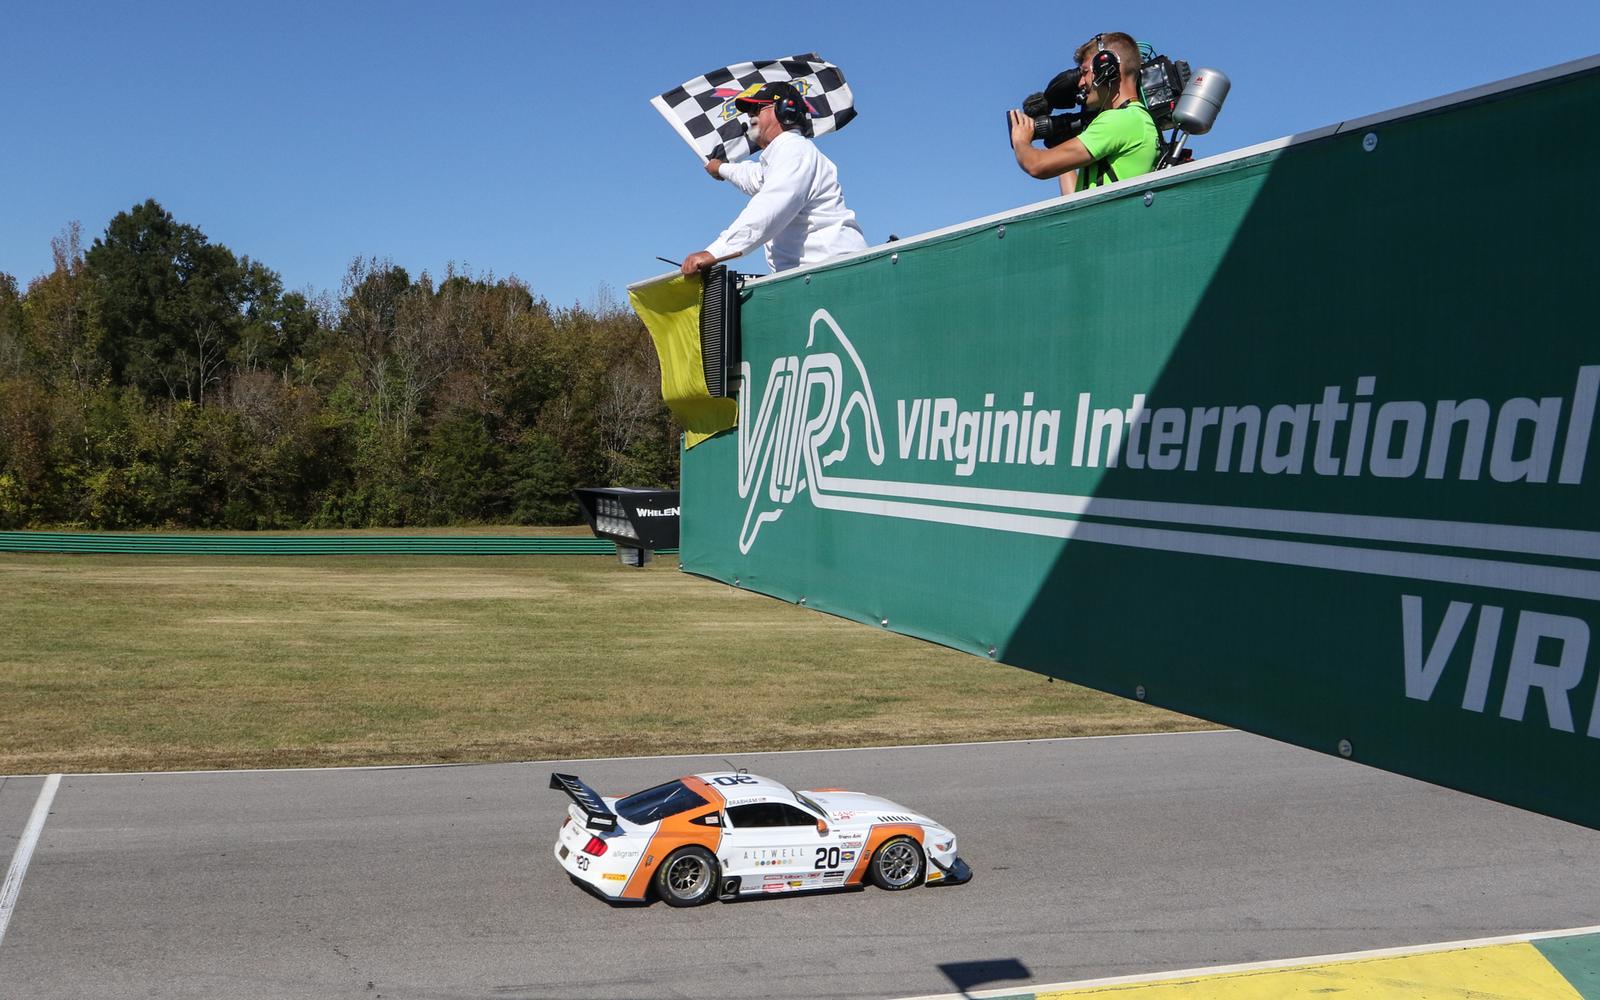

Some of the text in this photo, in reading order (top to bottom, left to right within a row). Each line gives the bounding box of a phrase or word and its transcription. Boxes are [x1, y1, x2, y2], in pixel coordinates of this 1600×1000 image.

[897, 364, 1600, 486] VIRginia International
[636, 507, 680, 517] WHELEN
[1401, 593, 1600, 740] VIR
[743, 848, 804, 859] ALTWELL
[815, 847, 840, 869] 20
